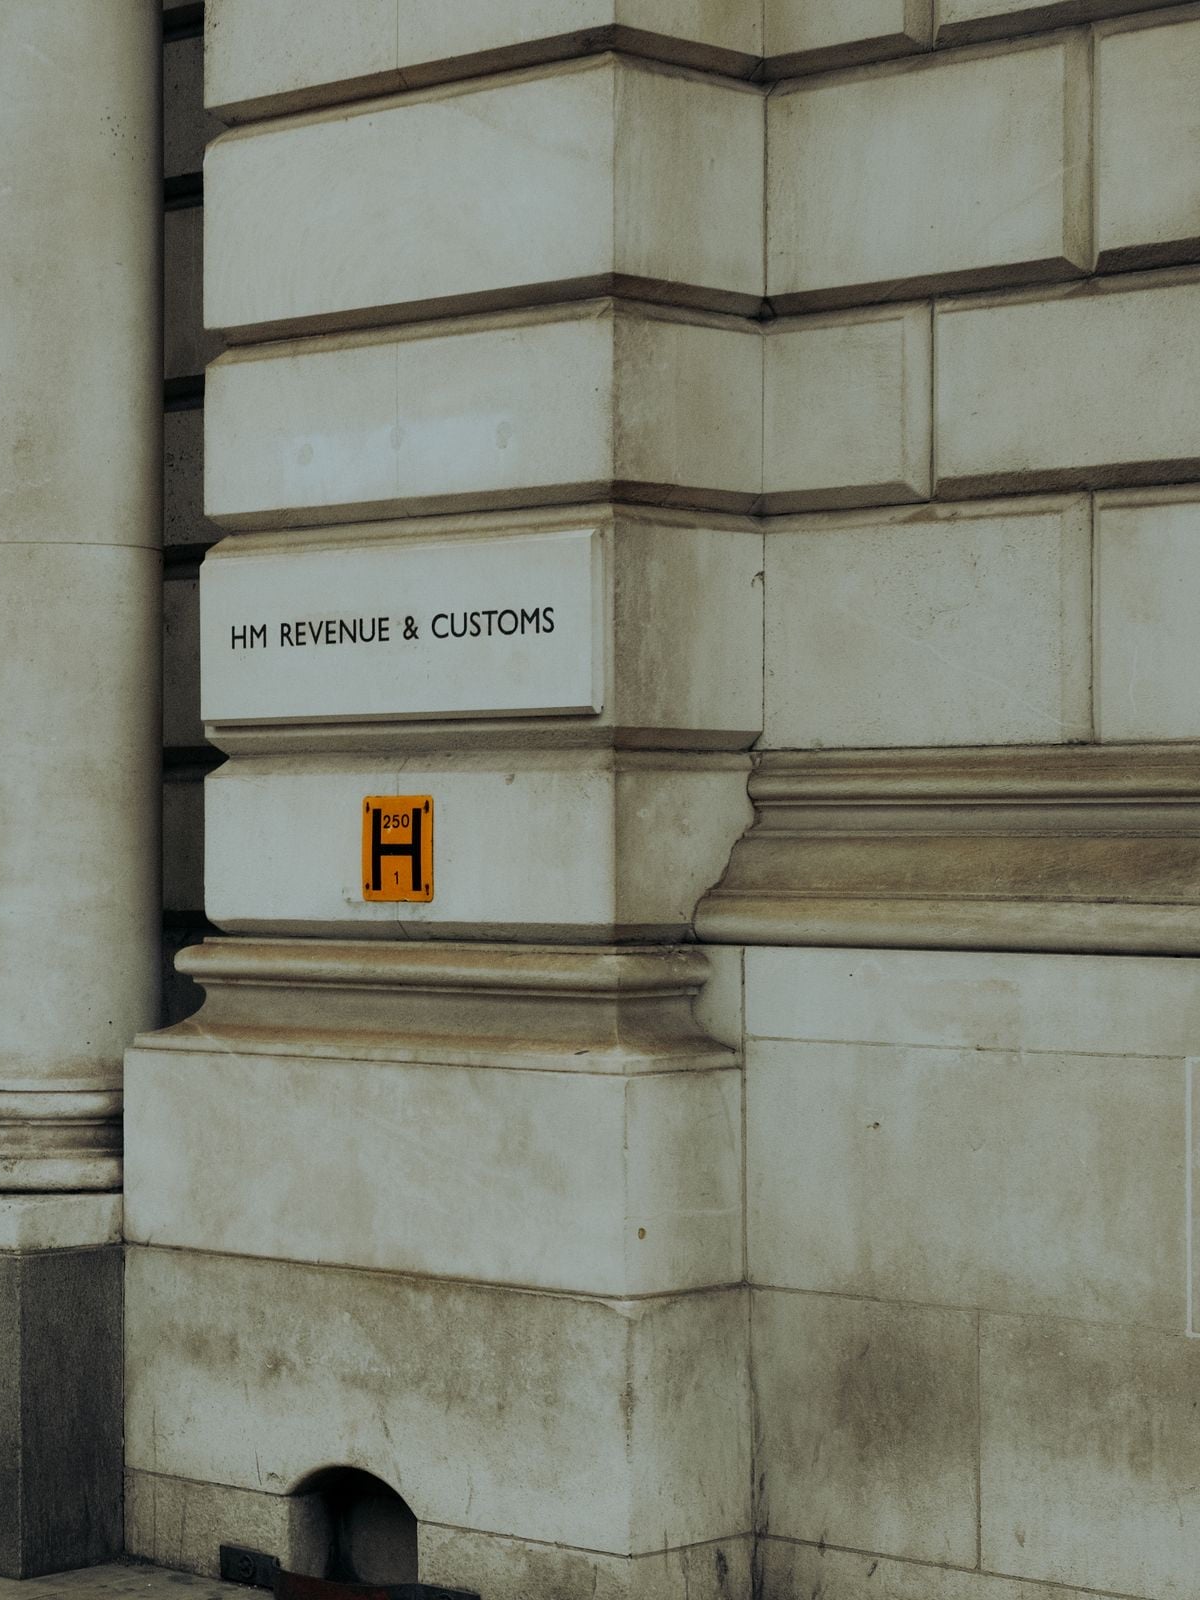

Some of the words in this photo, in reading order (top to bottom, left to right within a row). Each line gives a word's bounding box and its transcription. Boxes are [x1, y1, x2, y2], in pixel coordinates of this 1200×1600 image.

[231, 623, 267, 650] HM
[280, 617, 390, 647] REVENUE
[402, 615, 419, 640] &
[431, 606, 555, 639] CUSTOMS
[383, 814, 410, 829] 250
[372, 808, 421, 890] H
[394, 871, 399, 885] 1
